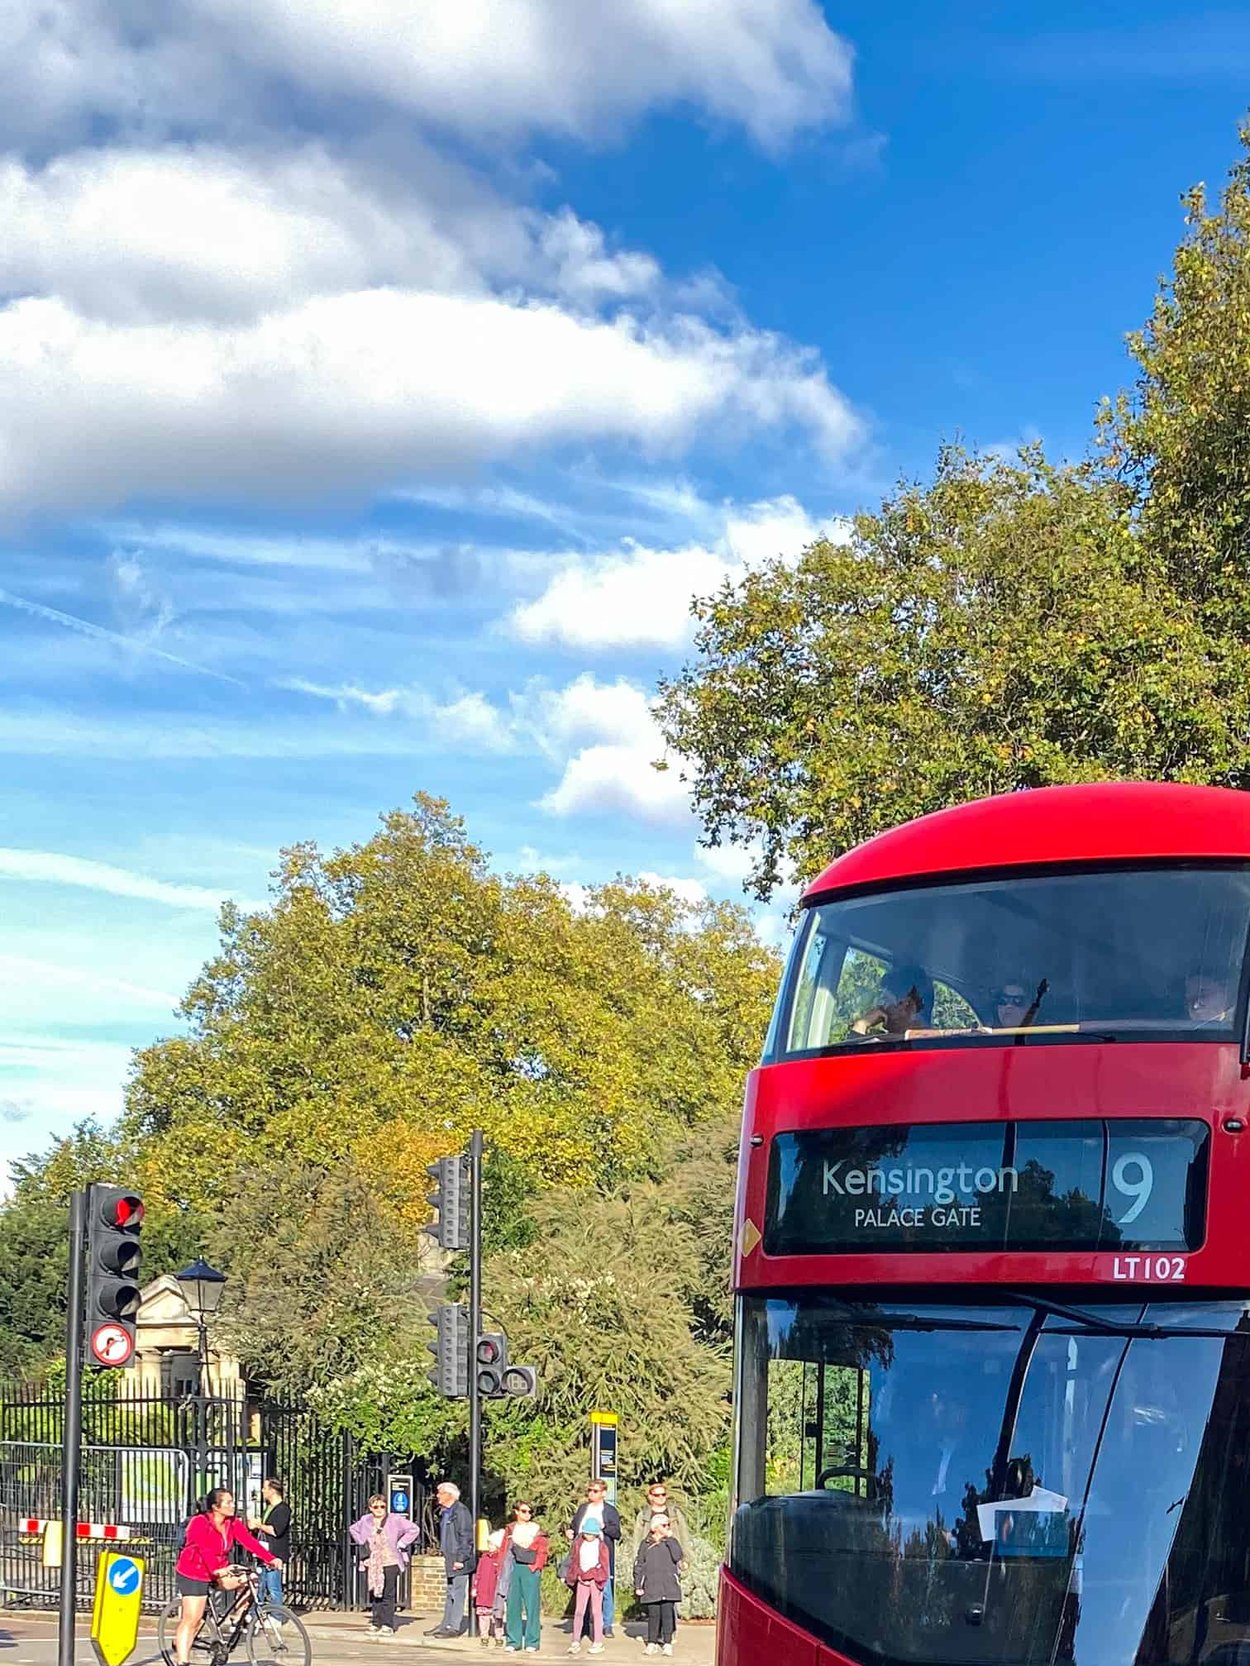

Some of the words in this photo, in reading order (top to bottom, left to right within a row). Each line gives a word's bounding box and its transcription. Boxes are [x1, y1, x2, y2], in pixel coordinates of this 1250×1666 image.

[822, 1159, 1018, 1204] Kensington
[1112, 1152, 1153, 1223] 9
[855, 1208, 925, 1227] PALACE
[931, 1207, 981, 1226] GATE
[1113, 1257, 1185, 1280] LT102
